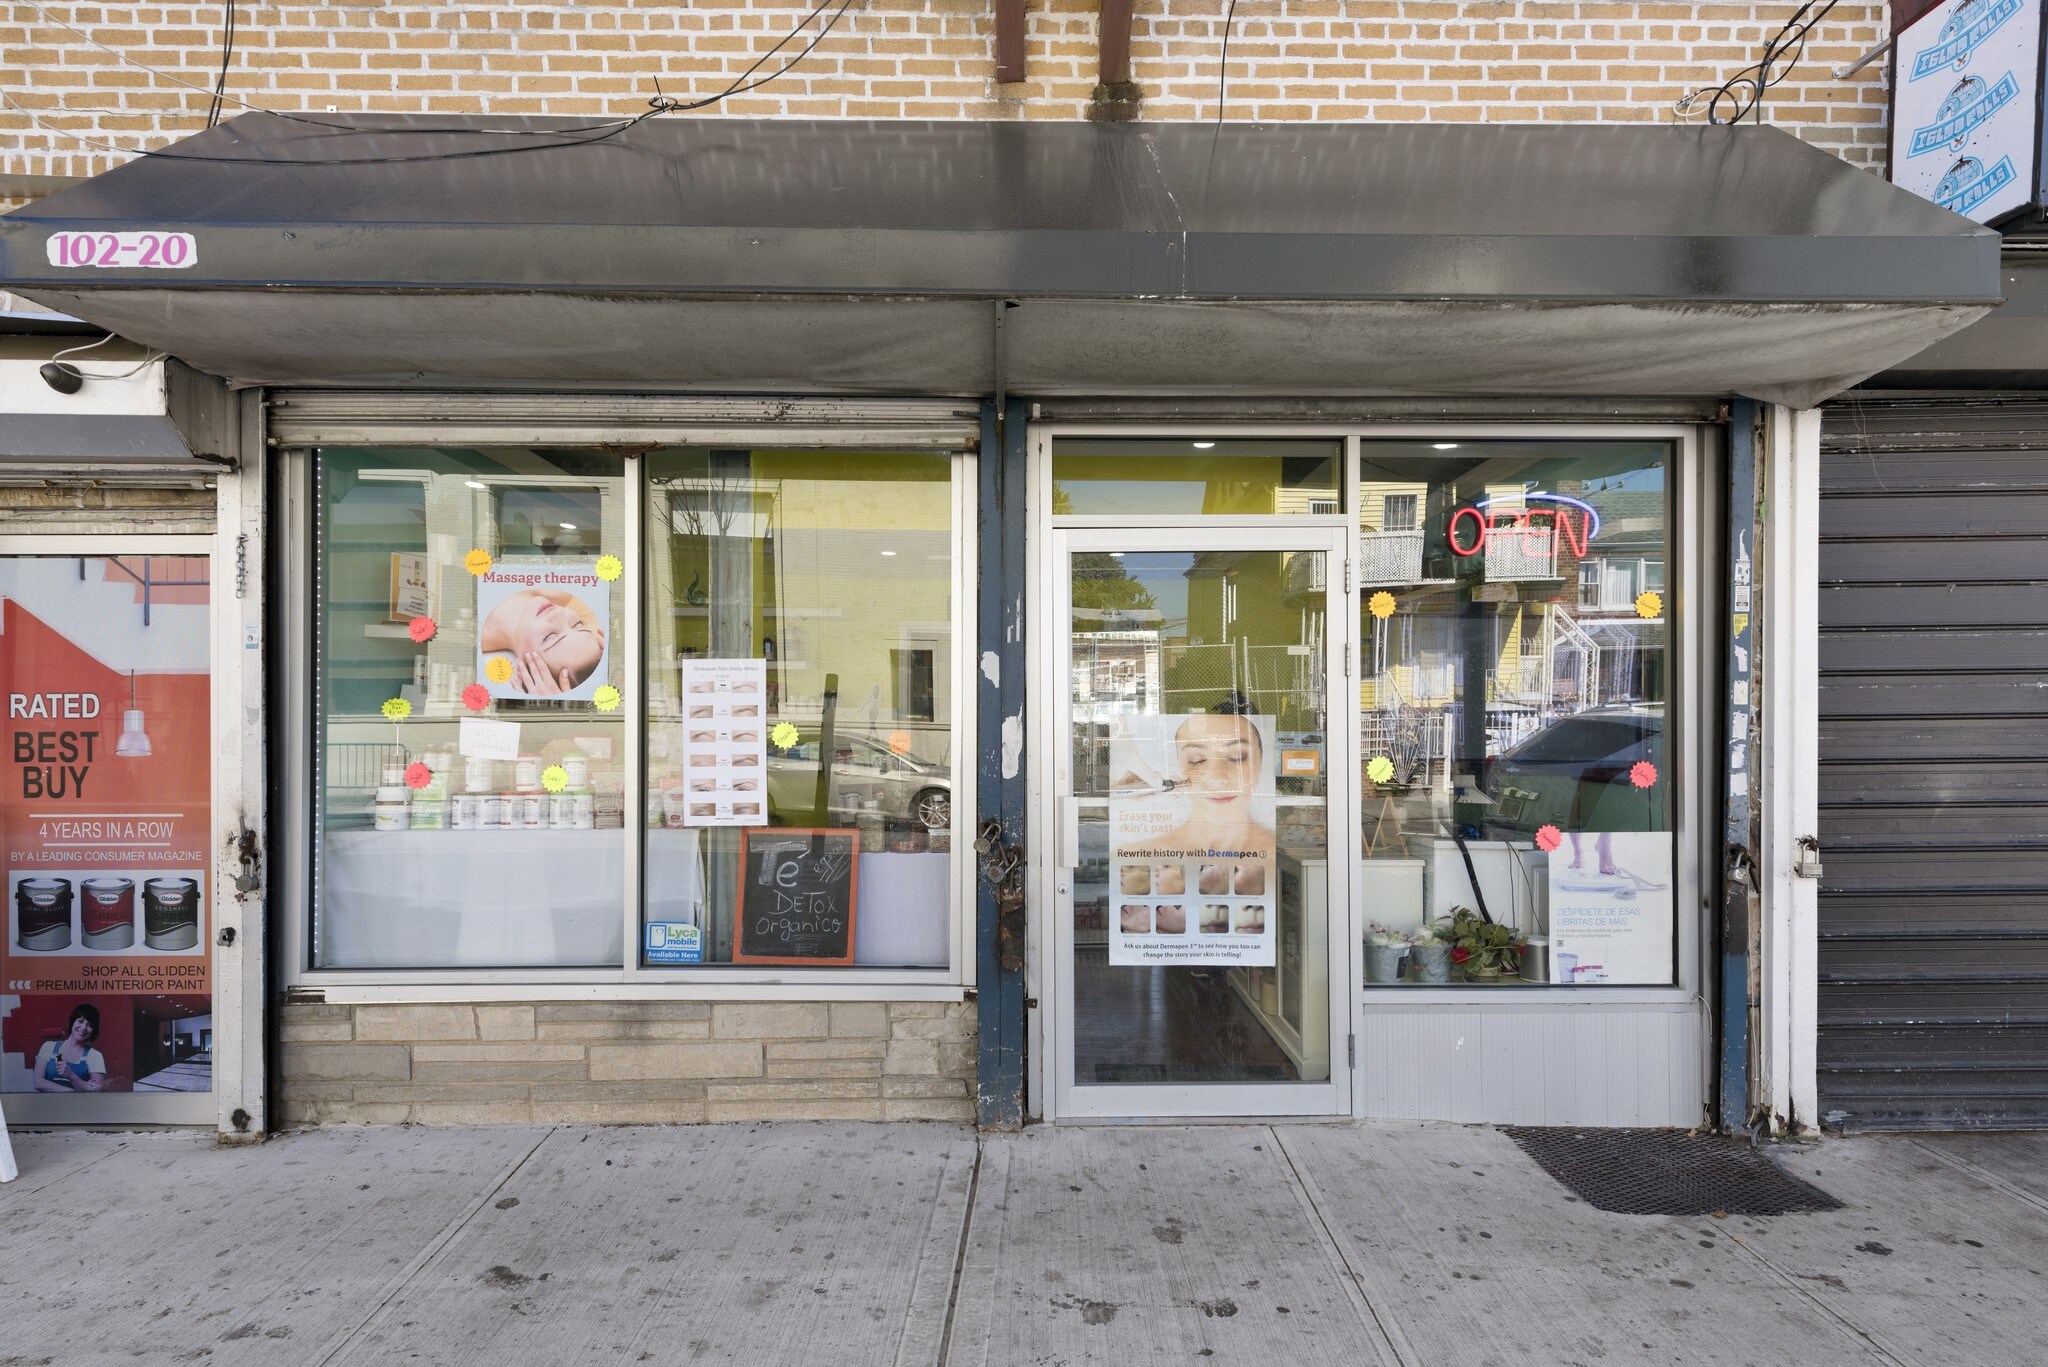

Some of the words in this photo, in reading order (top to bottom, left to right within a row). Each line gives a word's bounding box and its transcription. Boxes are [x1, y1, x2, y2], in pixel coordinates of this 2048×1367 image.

[1918, 38, 1968, 73] IGLOO
[1969, 0, 2013, 46] ROLLS
[1916, 115, 1965, 149] IGLOO
[1966, 81, 2009, 127] ROLLS
[1963, 166, 2007, 208] ROLLS
[54, 234, 187, 266] 102-20
[1450, 507, 1590, 558] OPEN
[482, 572, 542, 587] Massage
[544, 572, 600, 587] therapy
[413, 623, 429, 637] Sale!
[9, 693, 100, 719] RATED
[468, 727, 496, 744] Help
[14, 731, 99, 763] BEST
[23, 766, 89, 799] BUY
[1119, 810, 1147, 821] Erase
[1149, 811, 1173, 823] your
[39, 823, 48, 838] 4
[51, 822, 102, 838] YEARS
[106, 822, 121, 838] IN
[123, 822, 135, 838] A
[137, 822, 174, 838] ROW
[1119, 822, 1149, 833] skin's
[1151, 823, 1173, 834] past
[11, 851, 26, 861] BY
[27, 851, 35, 861] A
[36, 851, 82, 861] LEADING
[84, 851, 146, 861] CONSUMER
[148, 851, 203, 861] MAGAZINE
[1117, 848, 1152, 858] Rewrite
[1153, 848, 1184, 859] history
[1186, 848, 1207, 858] with
[1207, 848, 1258, 859] Dermapen
[1556, 906, 1604, 916] DESPÍDETE
[1605, 907, 1617, 916] DE
[1618, 907, 1641, 916] ESAS
[1557, 918, 1594, 926] LIBRITAS
[1595, 918, 1607, 926] DE
[1609, 917, 1628, 926] MÁS
[667, 927, 698, 939] Lyca
[1160, 943, 1189, 951] Dermapen
[1221, 951, 1242, 959] telling!
[82, 966, 122, 977] SHOP
[123, 966, 144, 977] ALL
[147, 966, 206, 977] GLIDDEN
[36, 980, 100, 991] PREMIUM
[102, 980, 165, 991] INTERIOR
[167, 980, 205, 990] PAINT
